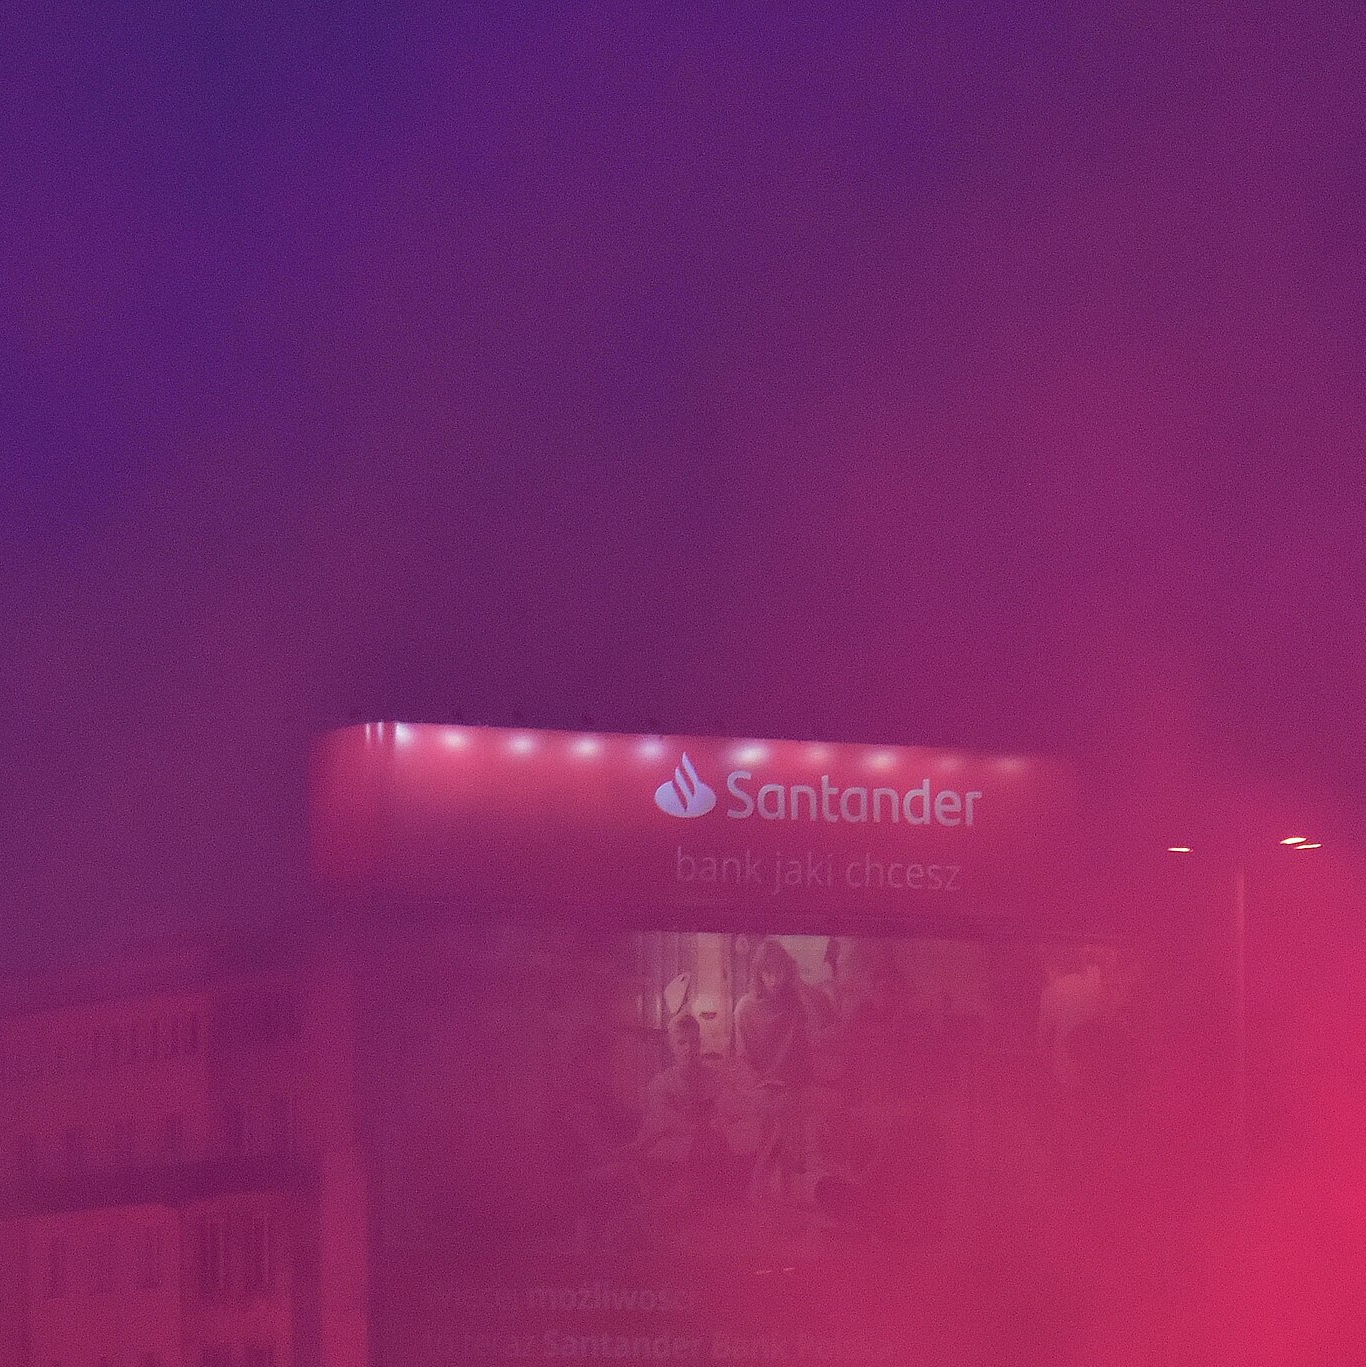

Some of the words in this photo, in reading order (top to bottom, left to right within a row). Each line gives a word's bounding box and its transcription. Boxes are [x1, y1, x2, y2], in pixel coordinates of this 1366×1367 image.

[726, 770, 983, 827] Santander
[676, 846, 762, 884] bank
[774, 851, 834, 896] jaki
[845, 852, 962, 891] chcesz
[541, 1329, 702, 1361] Santander
[710, 1330, 789, 1361] Bank
